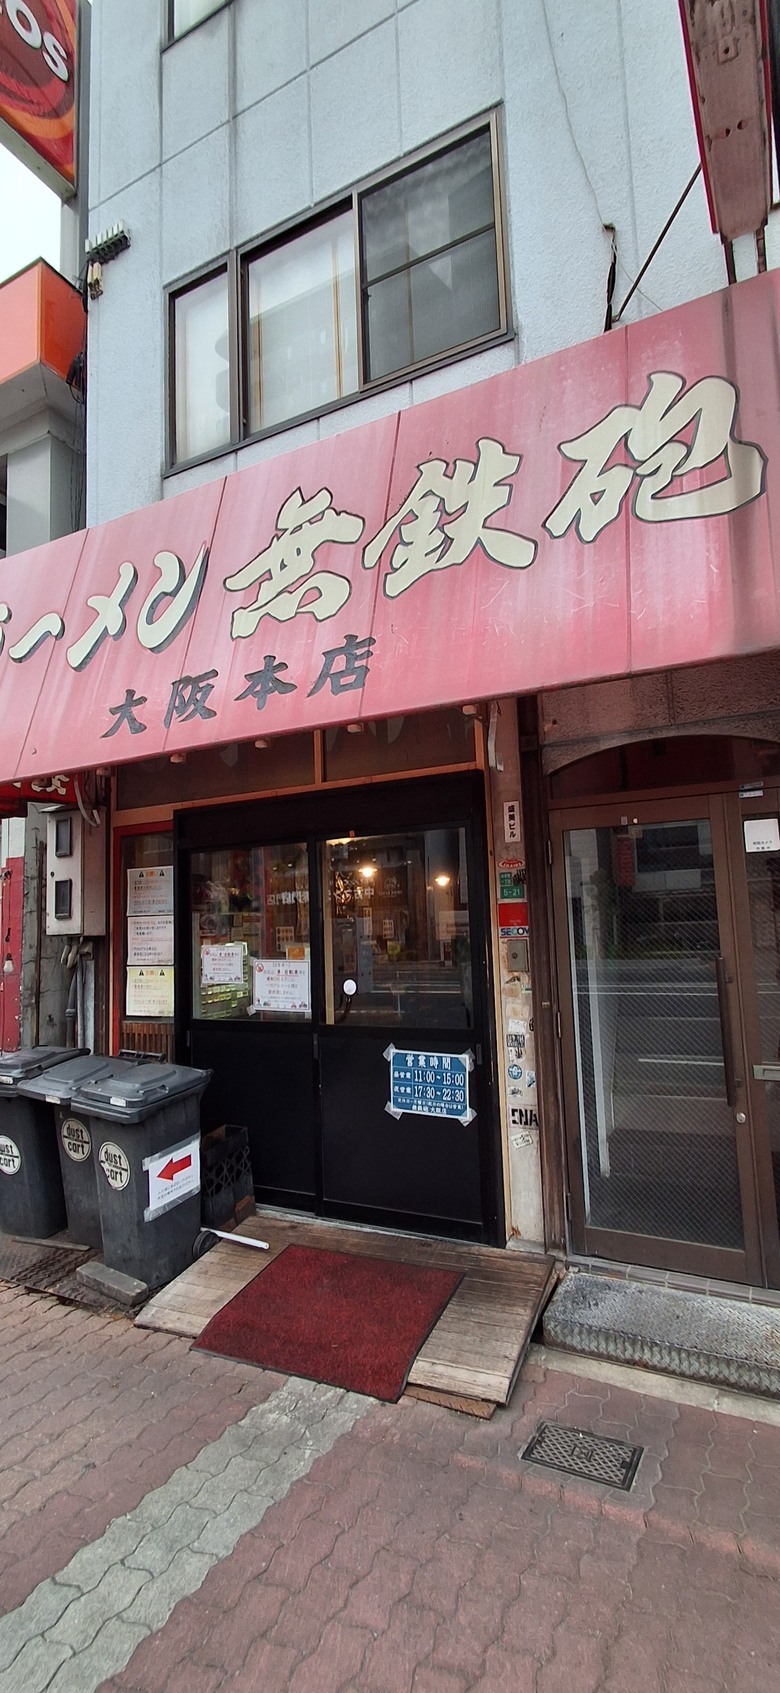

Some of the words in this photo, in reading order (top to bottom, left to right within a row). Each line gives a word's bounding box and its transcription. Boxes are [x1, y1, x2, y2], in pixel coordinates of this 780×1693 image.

[0, 0, 69, 82] OS
[0, 541, 208, 672] ーメン
[223, 371, 768, 641] 無鉄砲
[100, 634, 376, 739] 大阪本店
[503, 888, 520, 896] 5-21
[405, 1054, 451, 1070] 営業時間
[66, 1124, 84, 1140] dust
[0, 1142, 15, 1154] ust
[68, 1142, 85, 1155] cart
[104, 1148, 122, 1166] dust
